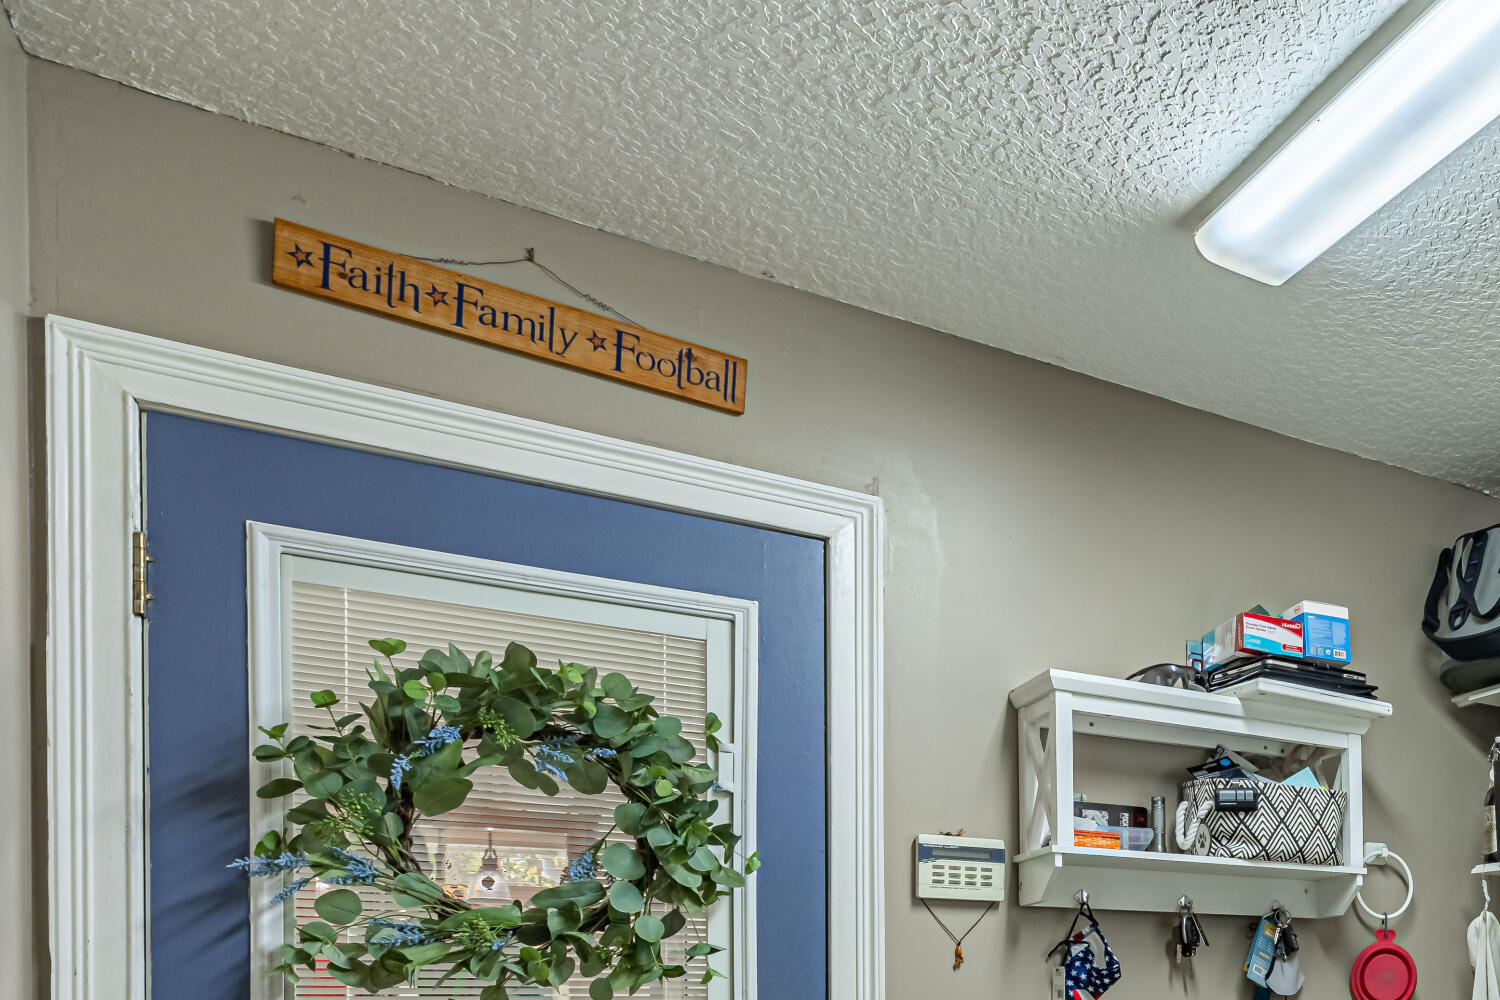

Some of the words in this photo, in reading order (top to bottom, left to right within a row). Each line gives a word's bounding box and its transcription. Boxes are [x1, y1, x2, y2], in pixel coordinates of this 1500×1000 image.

[318, 240, 420, 313] Faith
[452, 281, 579, 357] Family
[612, 329, 738, 405] Football
